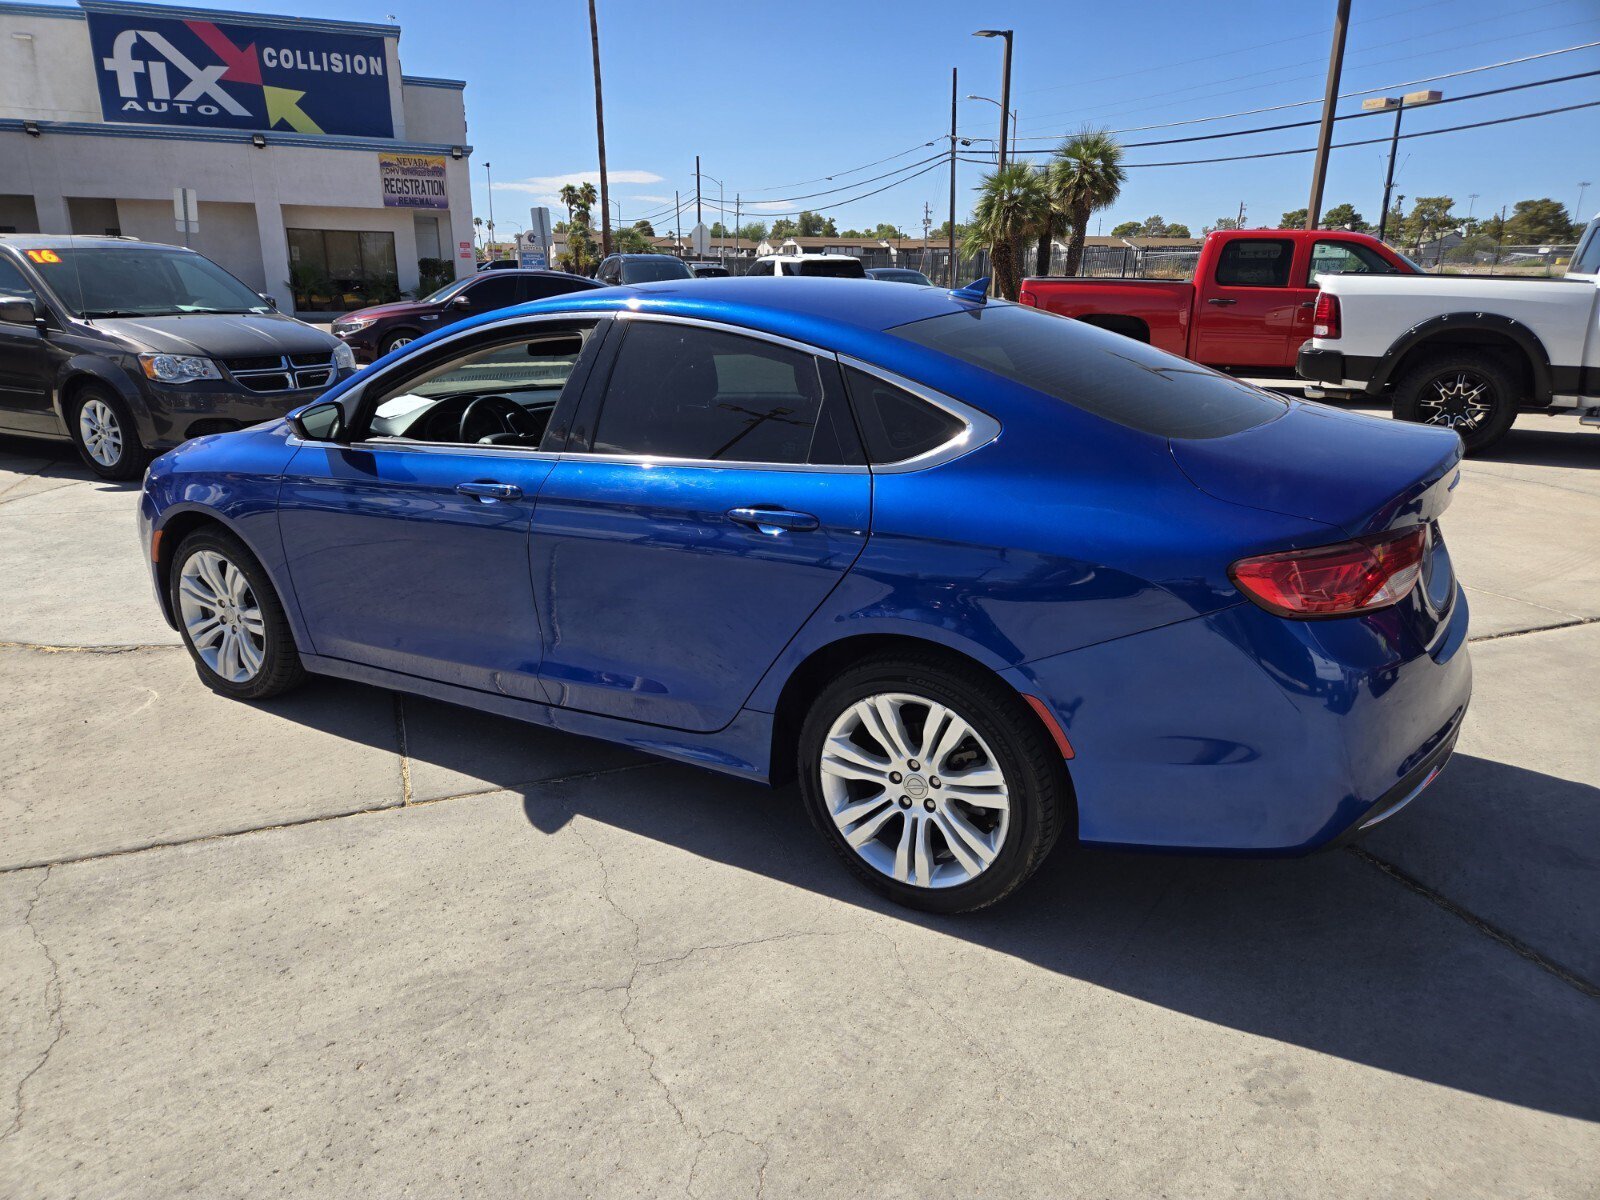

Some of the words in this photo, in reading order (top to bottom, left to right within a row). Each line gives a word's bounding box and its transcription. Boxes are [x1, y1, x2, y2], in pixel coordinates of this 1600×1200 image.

[262, 46, 384, 76] COLLISION
[103, 30, 254, 117] fix
[121, 100, 220, 116] AUTO
[396, 157, 429, 167] NEVADA
[385, 167, 400, 175] DMV
[384, 177, 445, 196] REGISTRATION
[398, 196, 435, 206] RENEWAL
[27, 250, 59, 263] 16
